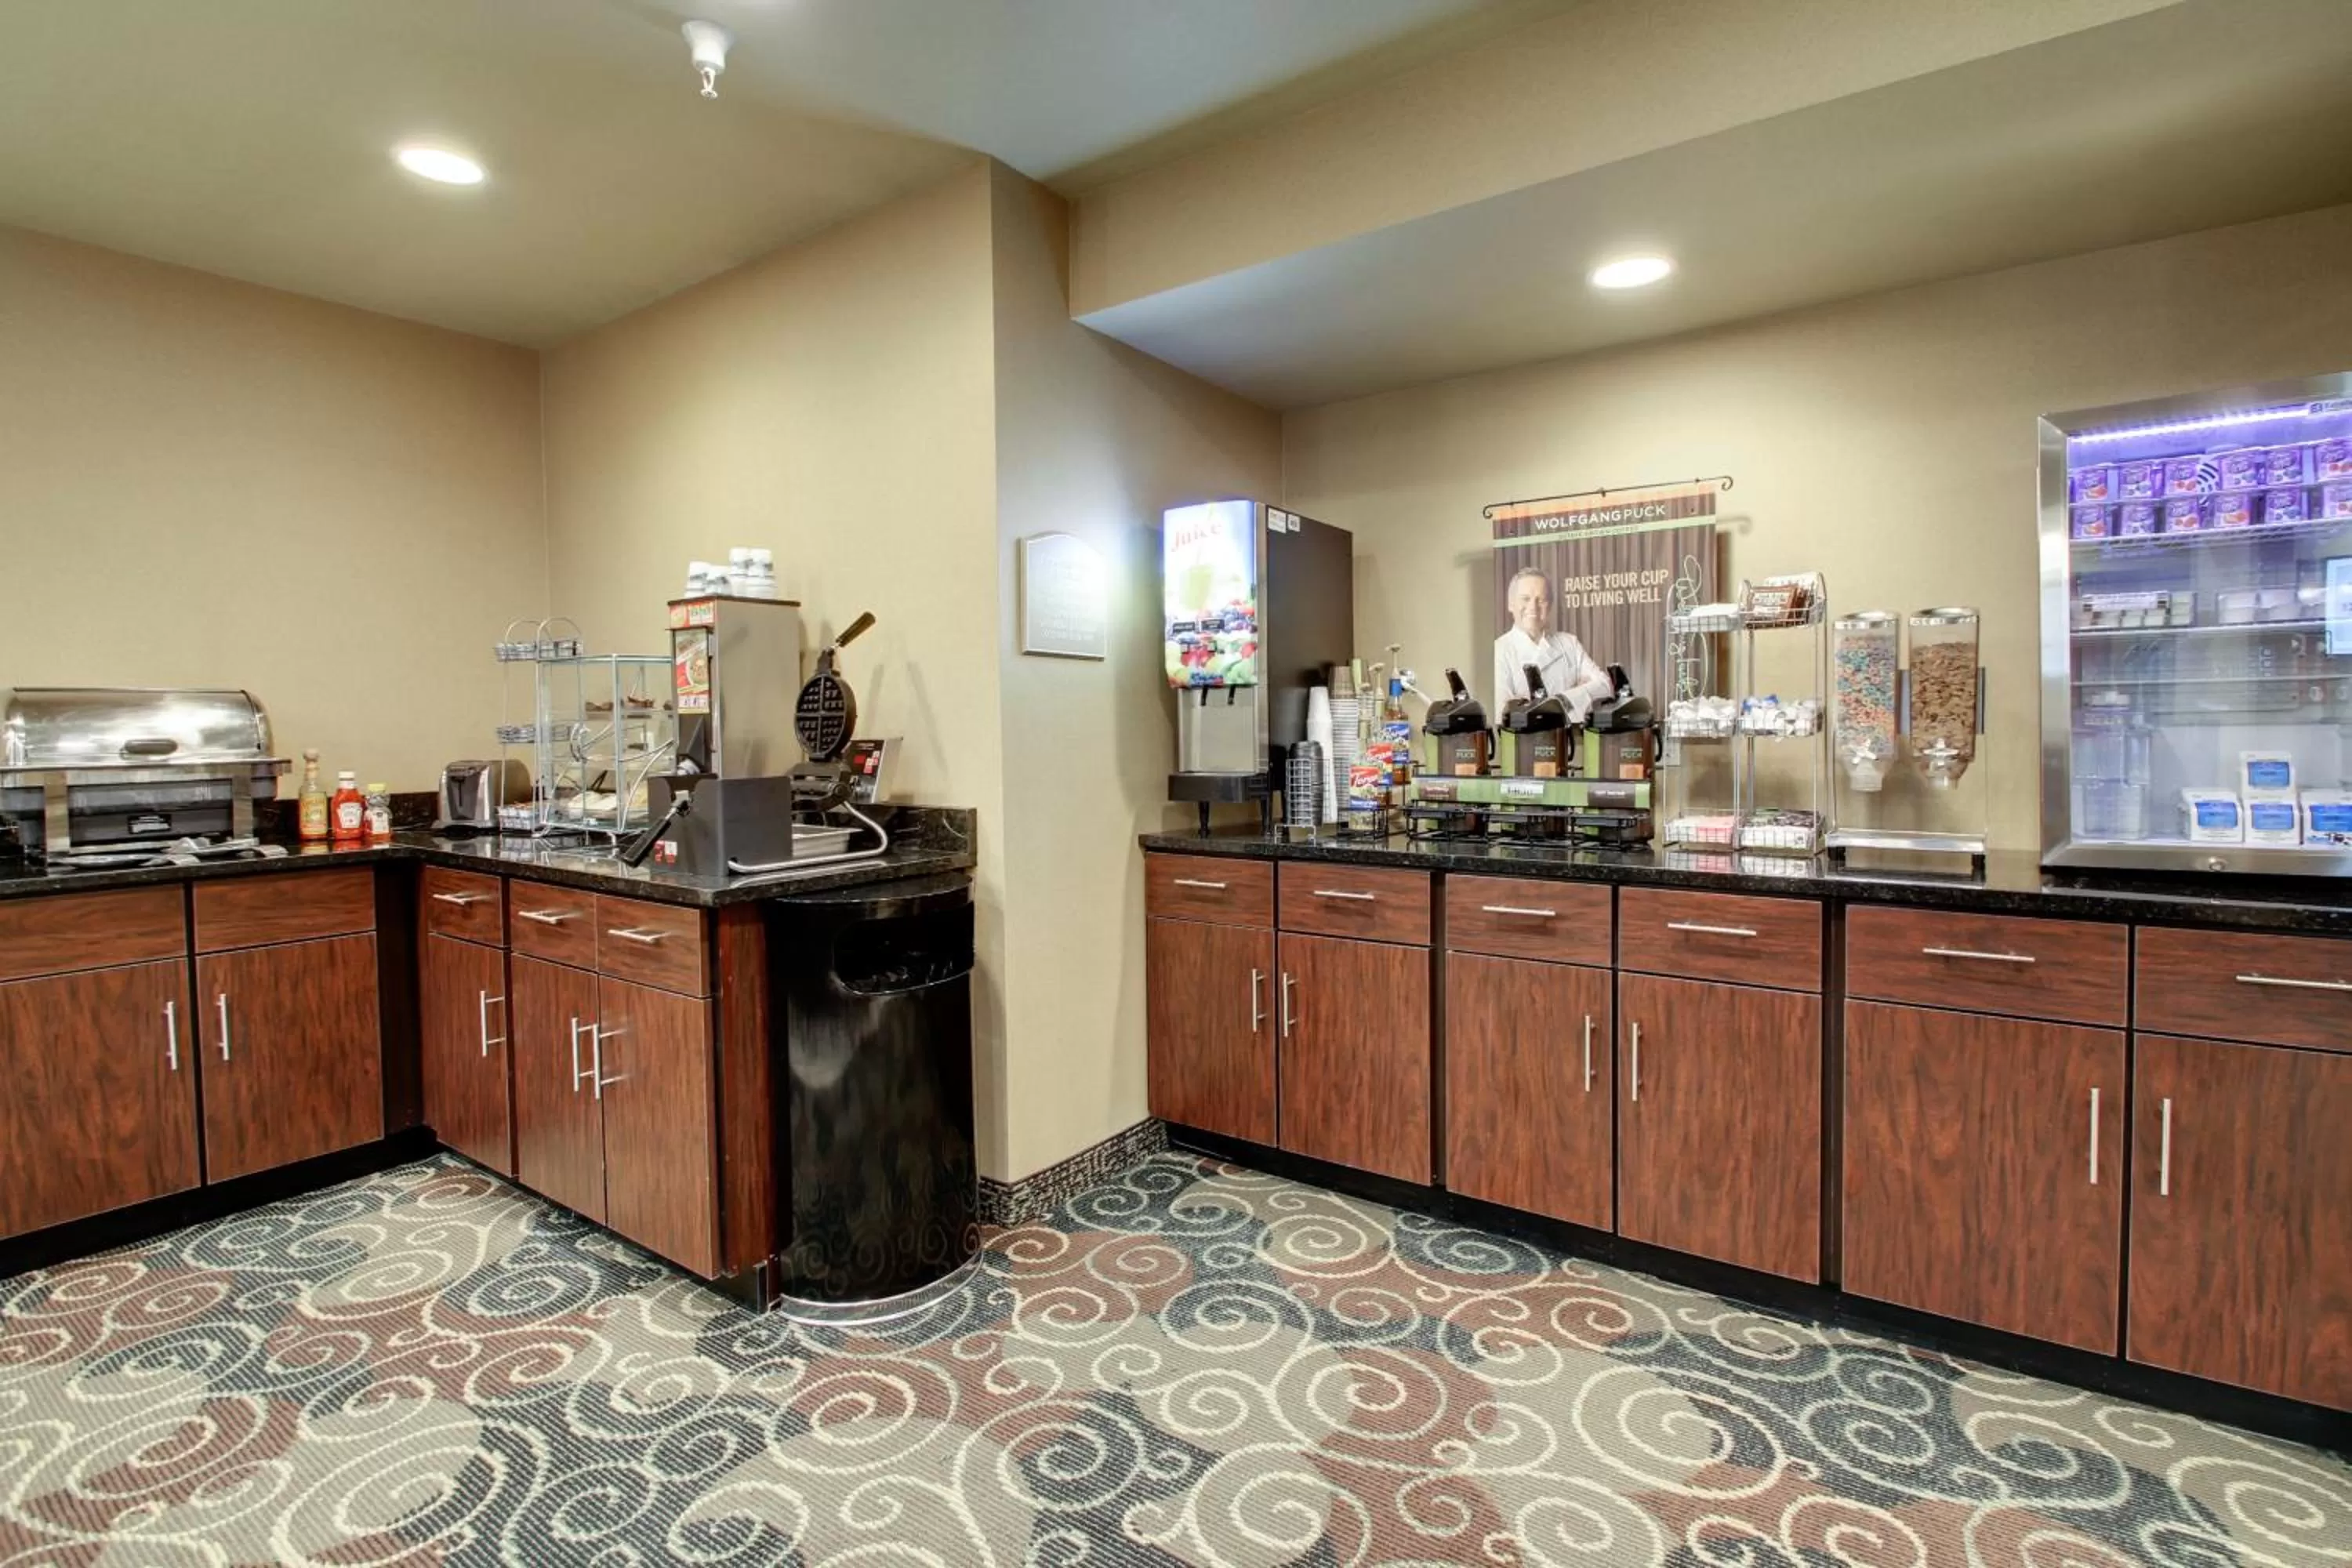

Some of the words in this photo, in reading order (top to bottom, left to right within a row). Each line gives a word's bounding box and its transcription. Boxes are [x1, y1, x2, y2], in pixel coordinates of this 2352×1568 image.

[1534, 511, 1621, 530] WOLFGANG
[1623, 504, 1666, 521] PUCK
[1564, 575, 1600, 592] RAISE
[1602, 572, 1638, 589] YOUR
[1641, 569, 1669, 586] CUP
[1564, 593, 1580, 608] TO
[1583, 590, 1624, 608] LIVING
[1625, 586, 1661, 604] WELL
